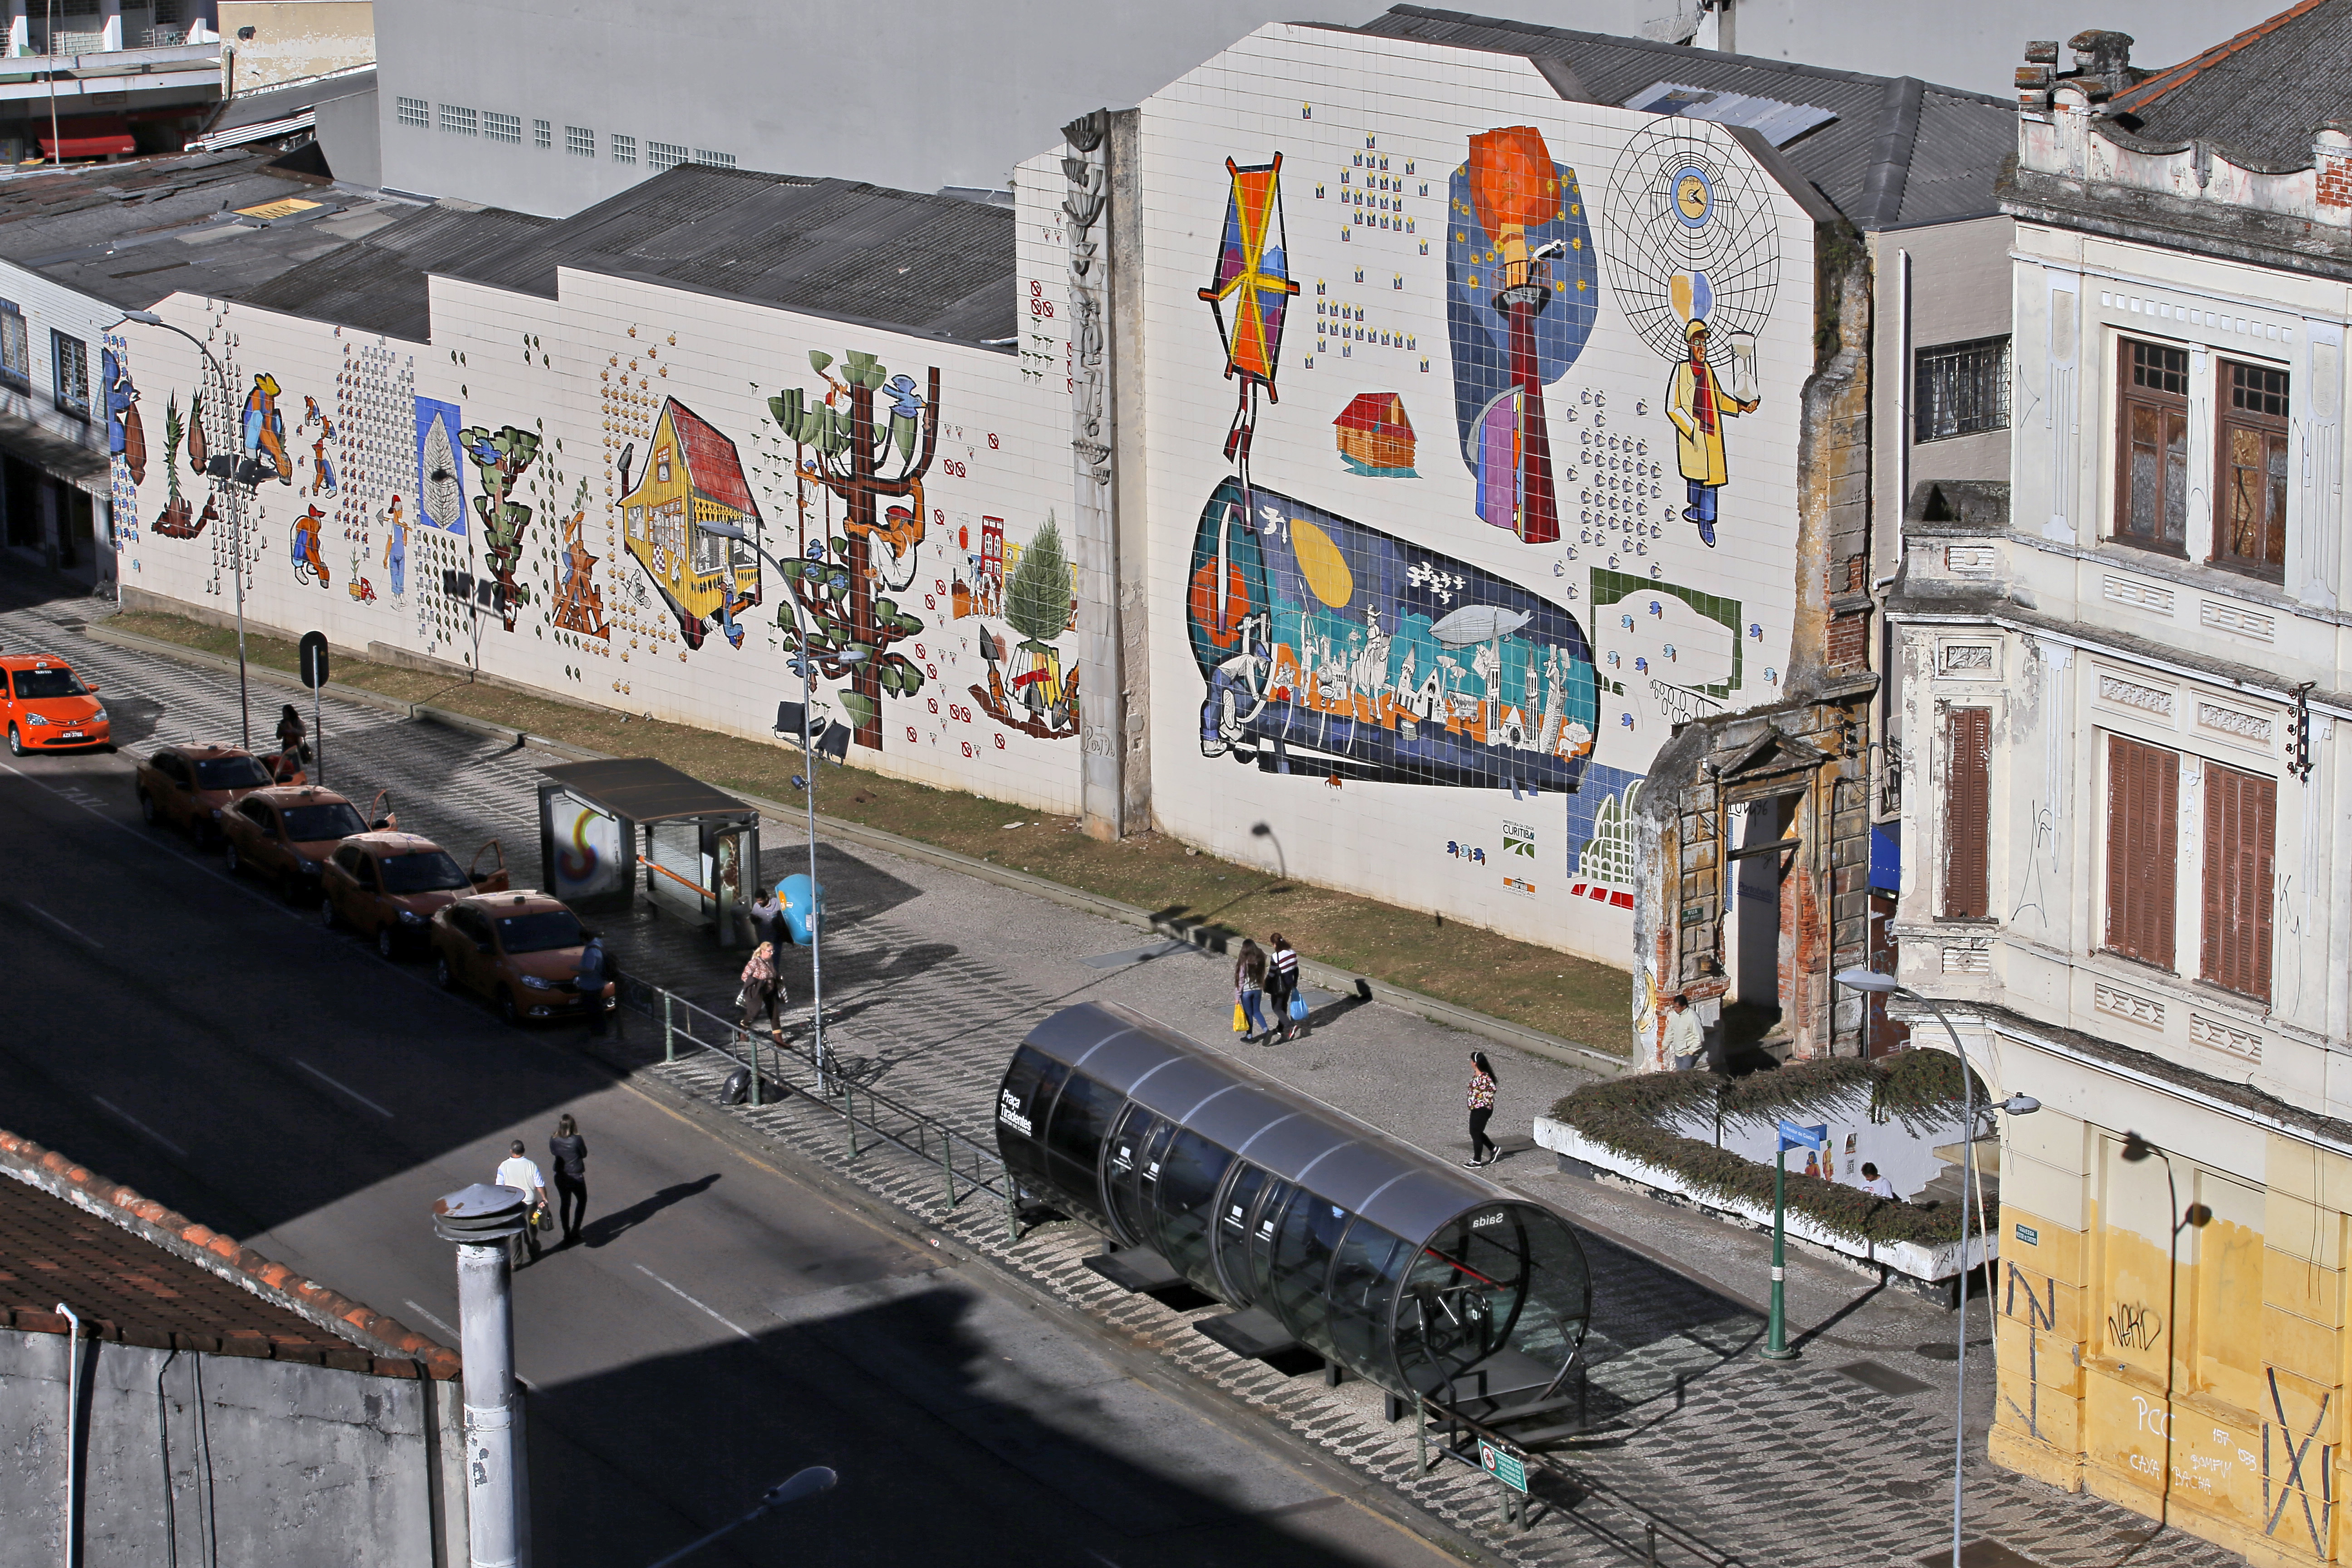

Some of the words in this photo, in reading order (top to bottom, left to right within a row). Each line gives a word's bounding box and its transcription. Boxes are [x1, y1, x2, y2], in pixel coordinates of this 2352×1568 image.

[1503, 824, 1534, 841] CURITIBA
[1739, 882, 1774, 898] Portobello
[1002, 1088, 1020, 1110] Praça
[1001, 1103, 1031, 1131] Tiradentes
[1803, 1133, 1815, 1141] Castro
[2132, 1396, 2176, 1441] PCC
